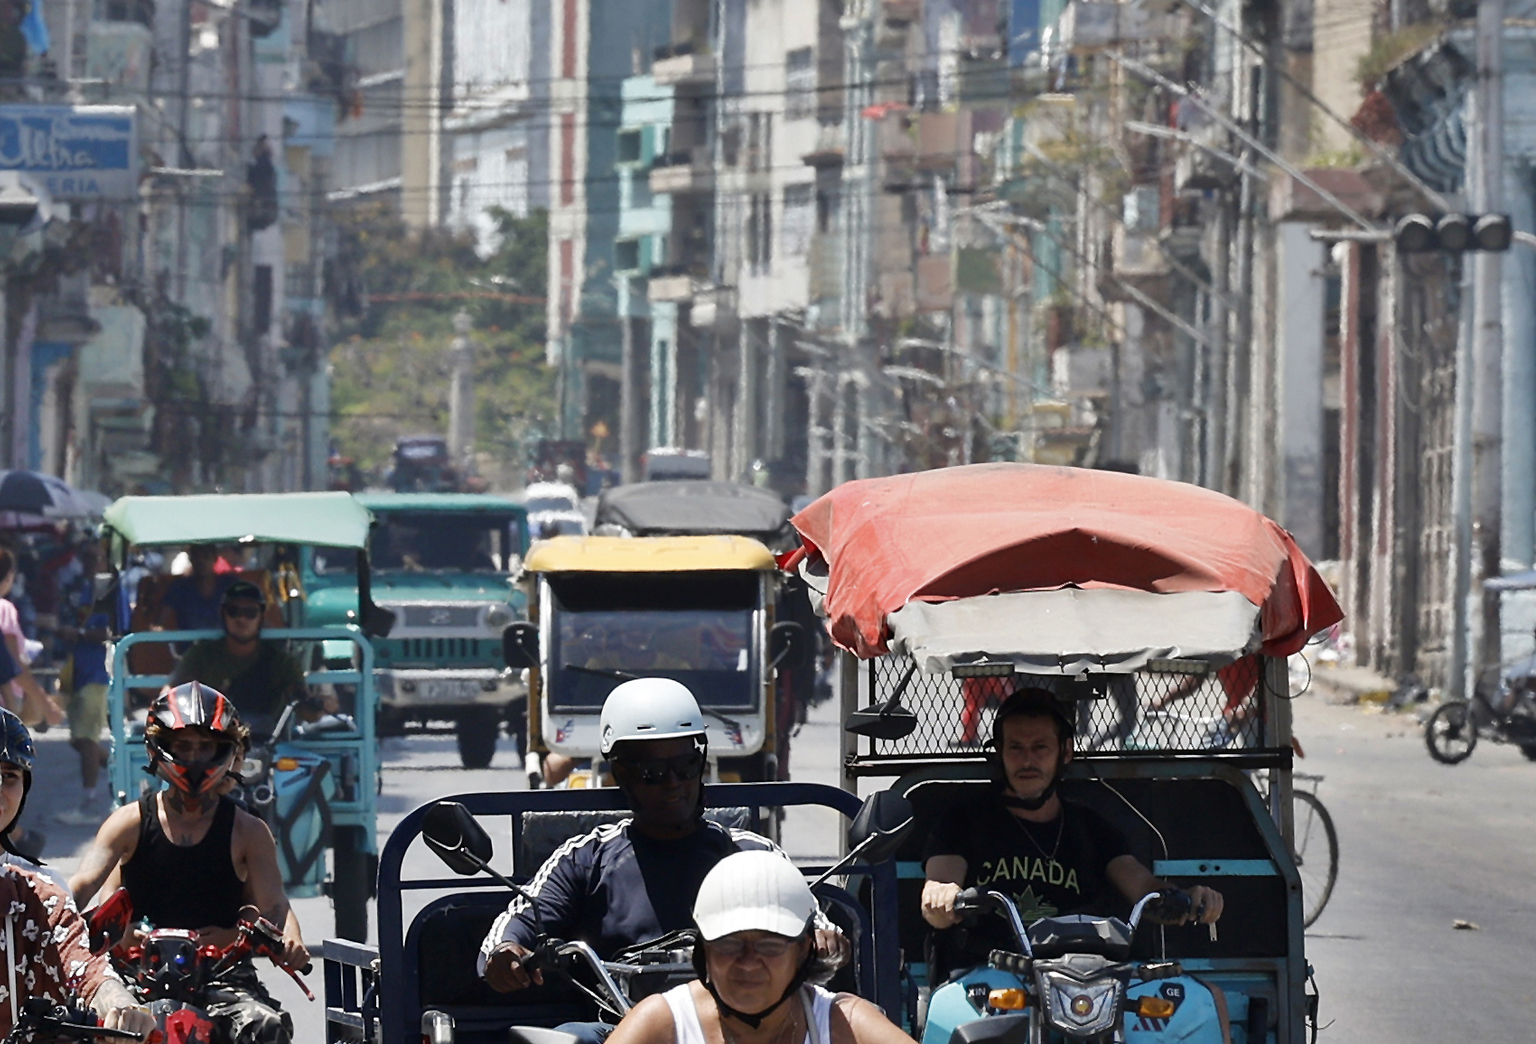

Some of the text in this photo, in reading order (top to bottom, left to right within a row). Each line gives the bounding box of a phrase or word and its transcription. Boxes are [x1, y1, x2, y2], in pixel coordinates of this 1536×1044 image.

[976, 856, 1081, 895] CANADA
[967, 987, 987, 997] XIN
[1166, 986, 1180, 998] GE
